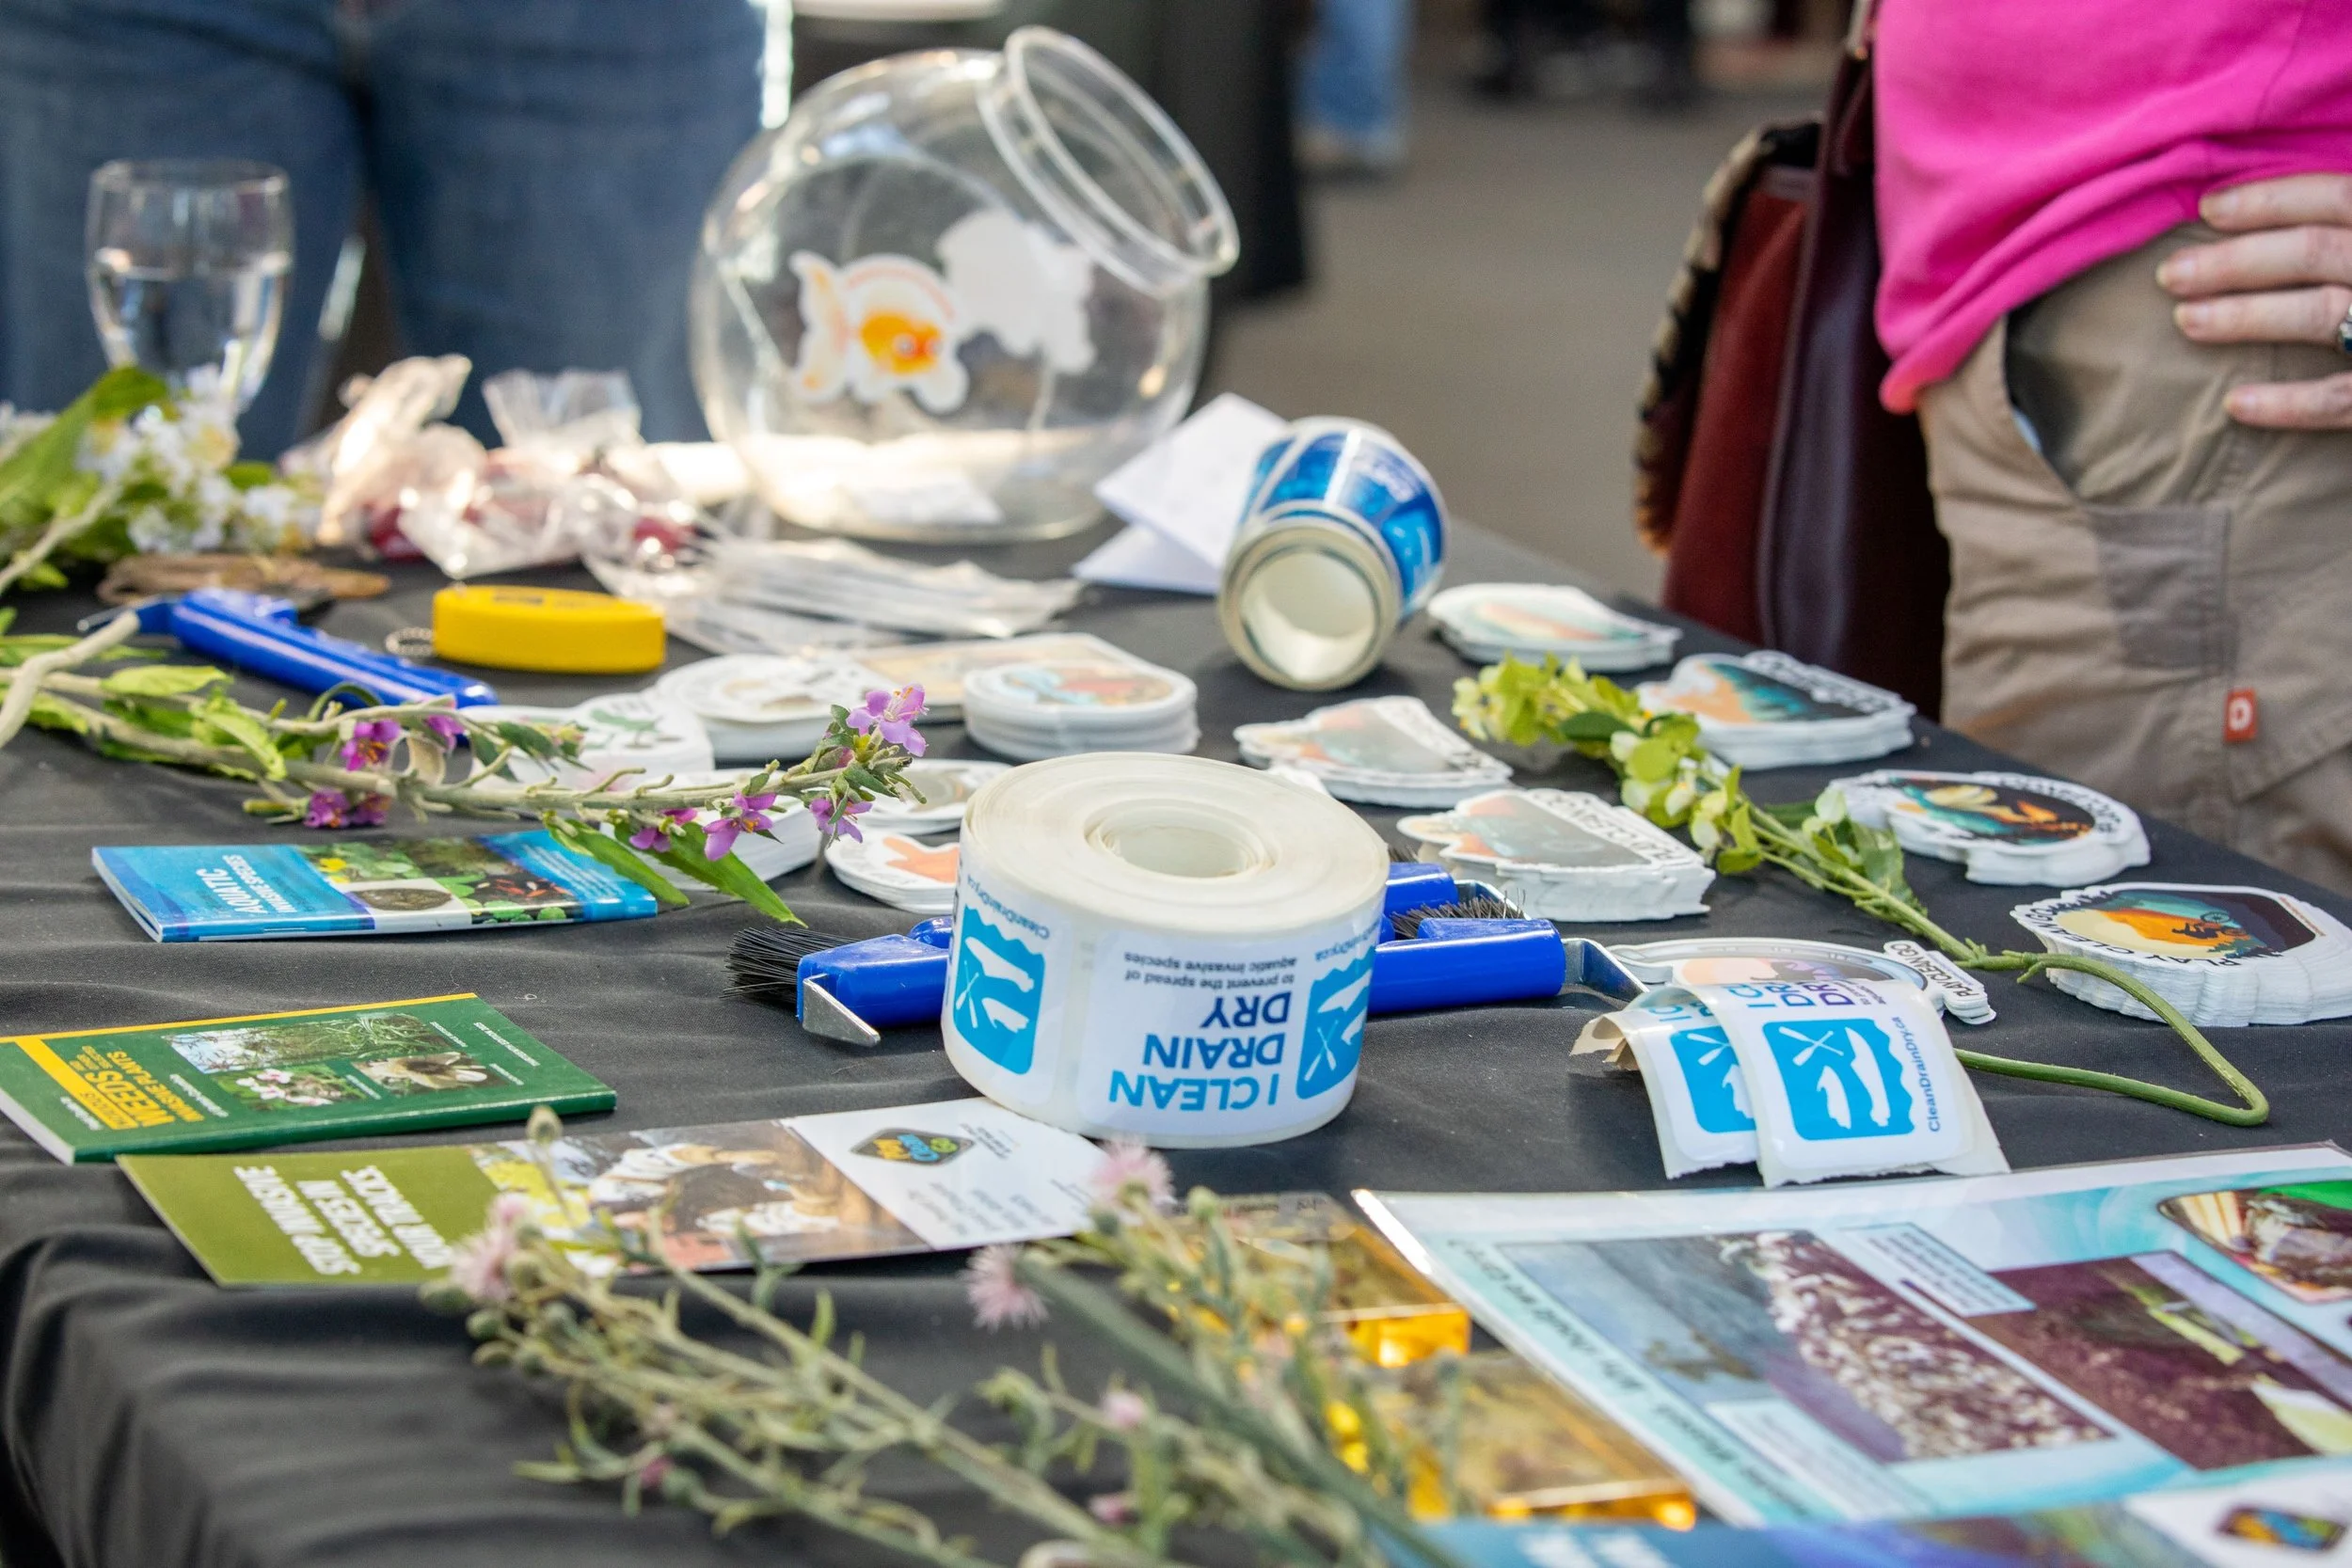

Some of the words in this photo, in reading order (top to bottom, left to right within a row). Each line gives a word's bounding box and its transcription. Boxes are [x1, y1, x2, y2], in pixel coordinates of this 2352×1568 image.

[222, 854, 265, 885] SPECIES
[196, 868, 268, 914] AQUATIC
[1891, 942, 1919, 958] GO
[2034, 921, 2135, 955] CLEAN
[1124, 952, 1181, 970] species
[1184, 959, 1246, 974] invasive
[1248, 957, 1297, 973] aquatic
[1904, 957, 1952, 981] CLEAN
[2146, 954, 2241, 966] PLAY
[1125, 970, 1141, 981] of
[1145, 972, 1196, 989] spread
[1200, 978, 1224, 990] the
[1226, 975, 1279, 990] prevent
[1281, 974, 1295, 985] to
[1797, 981, 1856, 1006] DR
[1937, 981, 1980, 997] PLAY
[1200, 991, 1293, 1029] DRY
[1143, 1034, 1286, 1070] DRAIN
[106, 1050, 159, 1085] PLANTS
[1891, 1015, 1943, 1133] CleanDrainDry.ca
[85, 1070, 176, 1127] WEEDS
[1108, 1069, 1261, 1113] CLEAN
[233, 1164, 326, 1236] INVASIVE
[295, 1180, 348, 1200] IN
[312, 1196, 403, 1257] SPECIES
[292, 1232, 362, 1275] STOP
[391, 1222, 455, 1270] YOUR
